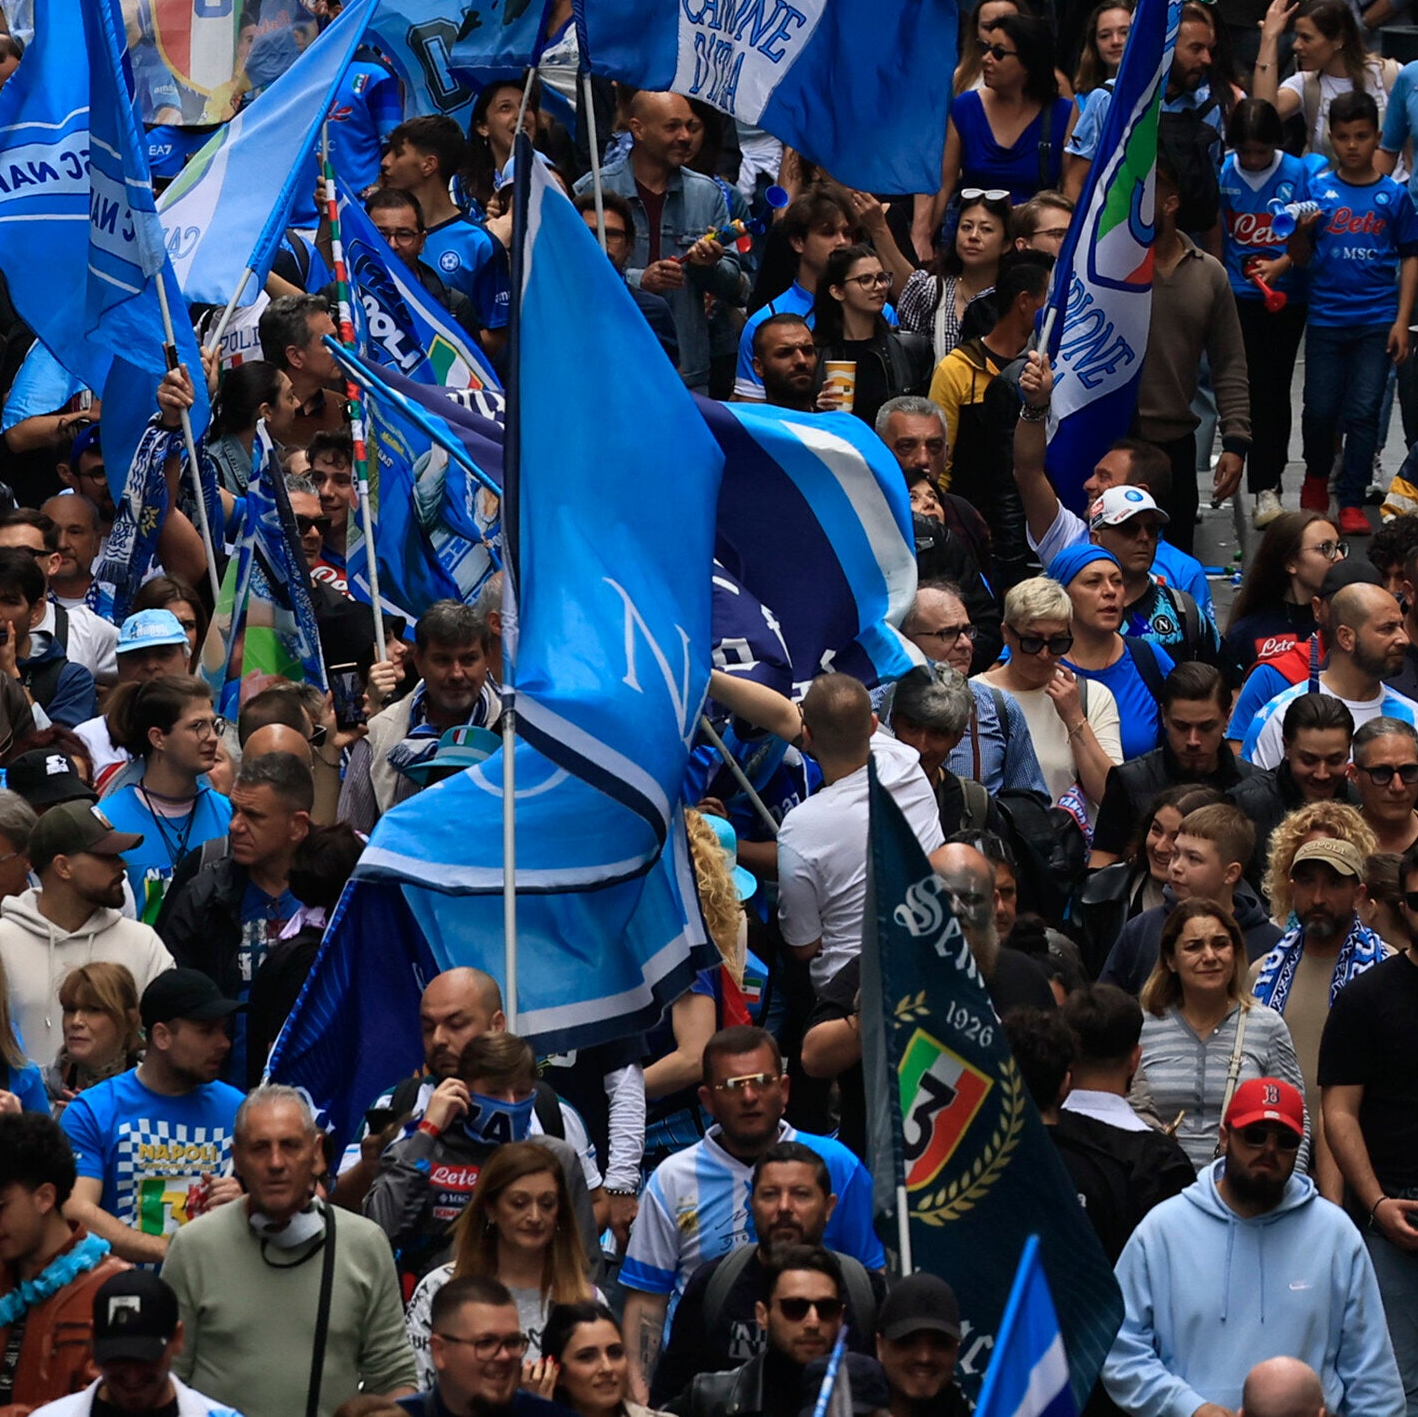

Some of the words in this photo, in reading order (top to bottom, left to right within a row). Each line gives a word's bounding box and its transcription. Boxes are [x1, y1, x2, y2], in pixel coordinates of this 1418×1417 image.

[148, 144, 173, 156] EA7
[1325, 206, 1386, 236] Lete
[1344, 246, 1379, 262] MSC
[1257, 637, 1296, 658] Lete
[944, 1000, 993, 1048] 1926
[138, 1144, 218, 1163] NAPOLI
[430, 1164, 478, 1188] Lete
